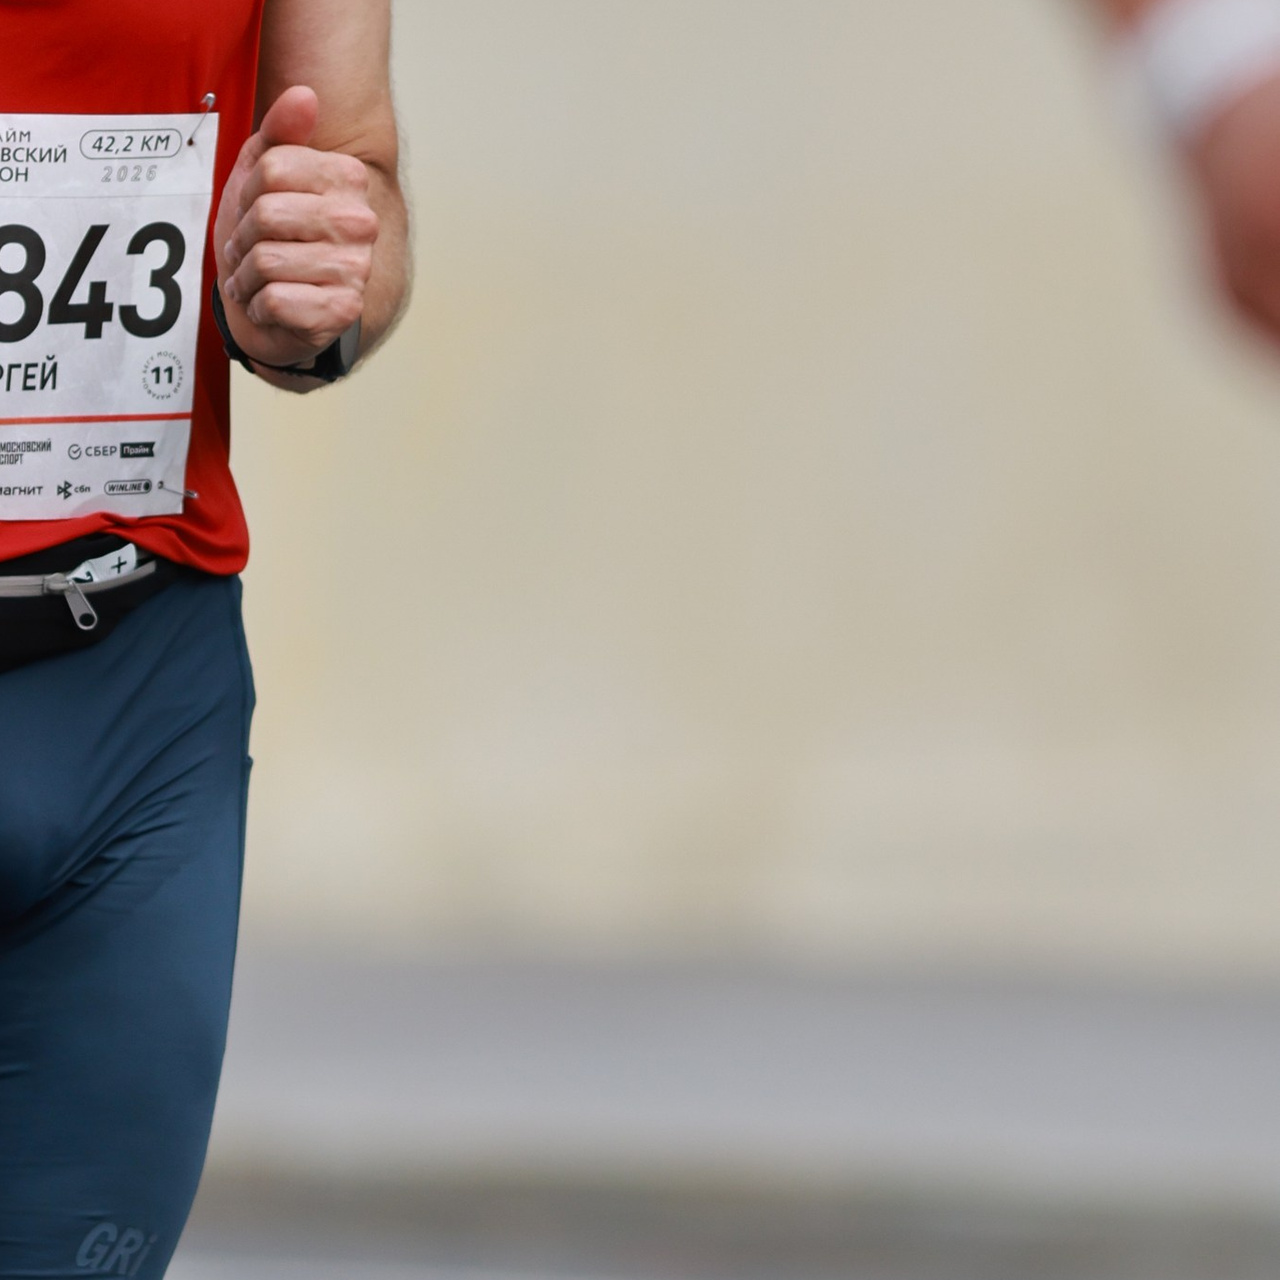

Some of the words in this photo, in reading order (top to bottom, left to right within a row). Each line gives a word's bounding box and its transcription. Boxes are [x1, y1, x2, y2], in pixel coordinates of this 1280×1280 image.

[91, 135, 134, 155] 42,2
[101, 164, 158, 182] 2026
[150, 365, 173, 384] 11
[0, 438, 52, 452] МОСКОВСКИЙ
[85, 446, 117, 457] СБЕР
[123, 446, 150, 455] Прайм
[0, 453, 24, 465] СПОРТ
[108, 483, 142, 492] WINLINE
